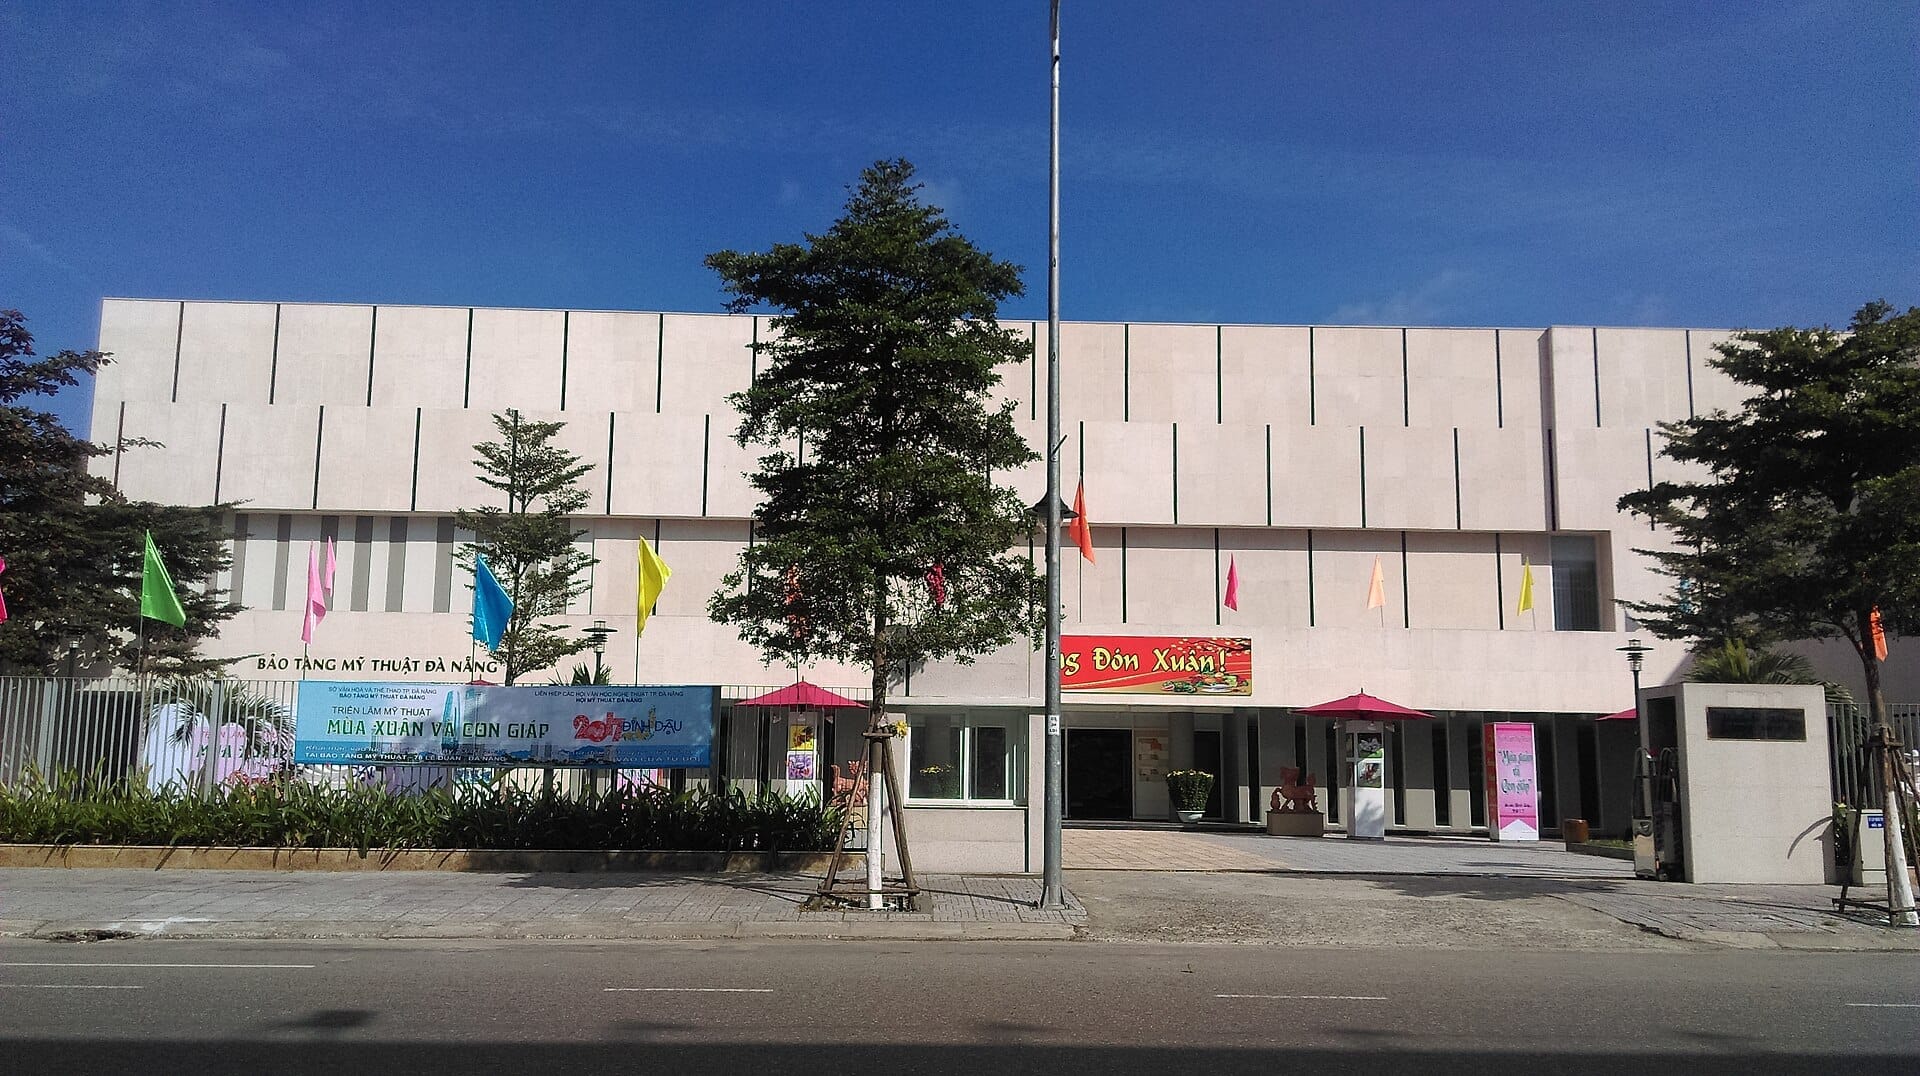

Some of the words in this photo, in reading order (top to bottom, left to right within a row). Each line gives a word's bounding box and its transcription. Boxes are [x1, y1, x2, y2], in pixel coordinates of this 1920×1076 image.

[257, 653, 289, 670] BẢO
[294, 656, 337, 671] TÀNG
[341, 657, 366, 671] MỸ
[371, 656, 421, 675] THUẬT
[425, 656, 446, 672] ĐÀ
[451, 656, 498, 673] NẴNG
[1093, 647, 1139, 672] Đón
[332, 706, 360, 715] TRIỂN
[362, 706, 382, 715] LÃM
[383, 706, 399, 716] MỸ
[400, 706, 432, 718] THUẬT
[327, 716, 366, 735] MÙA
[374, 717, 424, 737] XUÂN
[432, 718, 455, 737] VÀ
[462, 722, 500, 738] CON
[507, 719, 550, 739] GIÁP
[654, 719, 683, 735] DẬU
